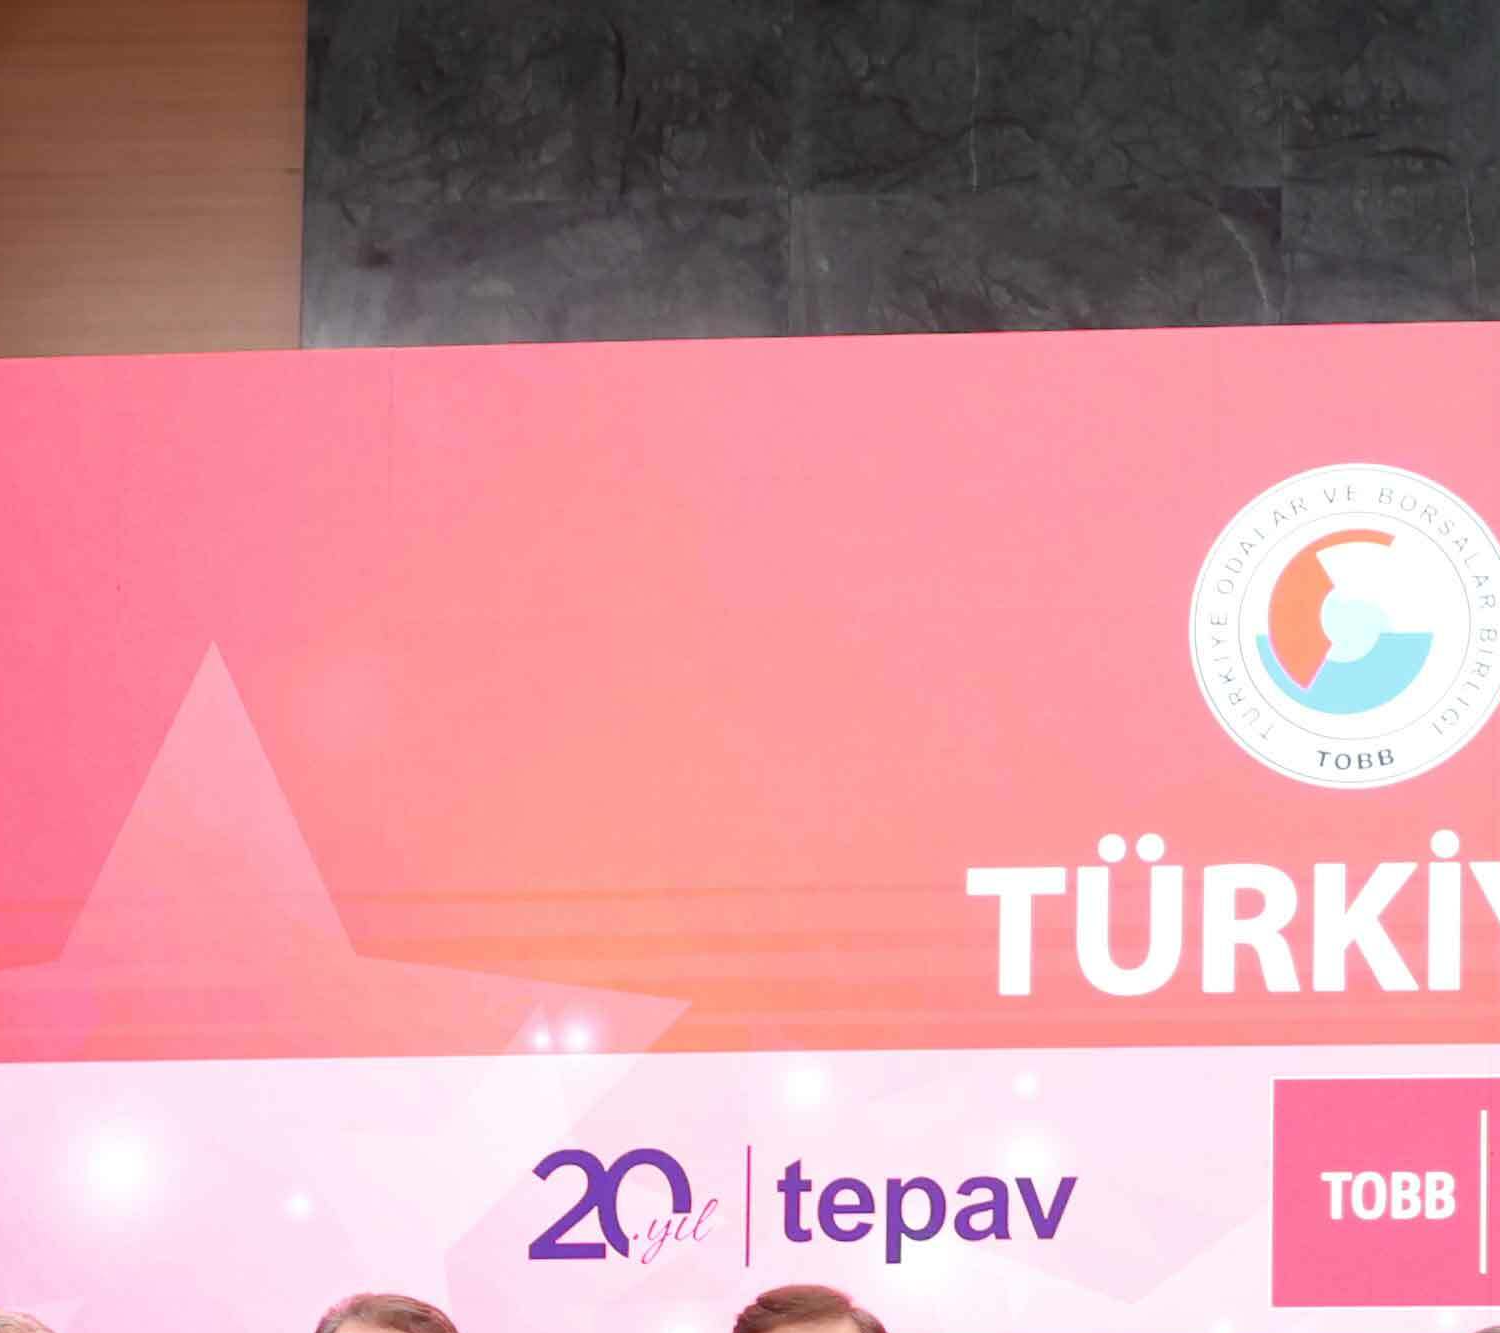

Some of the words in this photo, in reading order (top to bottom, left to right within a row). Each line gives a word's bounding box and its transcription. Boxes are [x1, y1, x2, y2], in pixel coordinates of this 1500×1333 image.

[1316, 748, 1395, 770] TOBB
[776, 1158, 1078, 1264] tepav
[1320, 1171, 1456, 1220] TOBB
